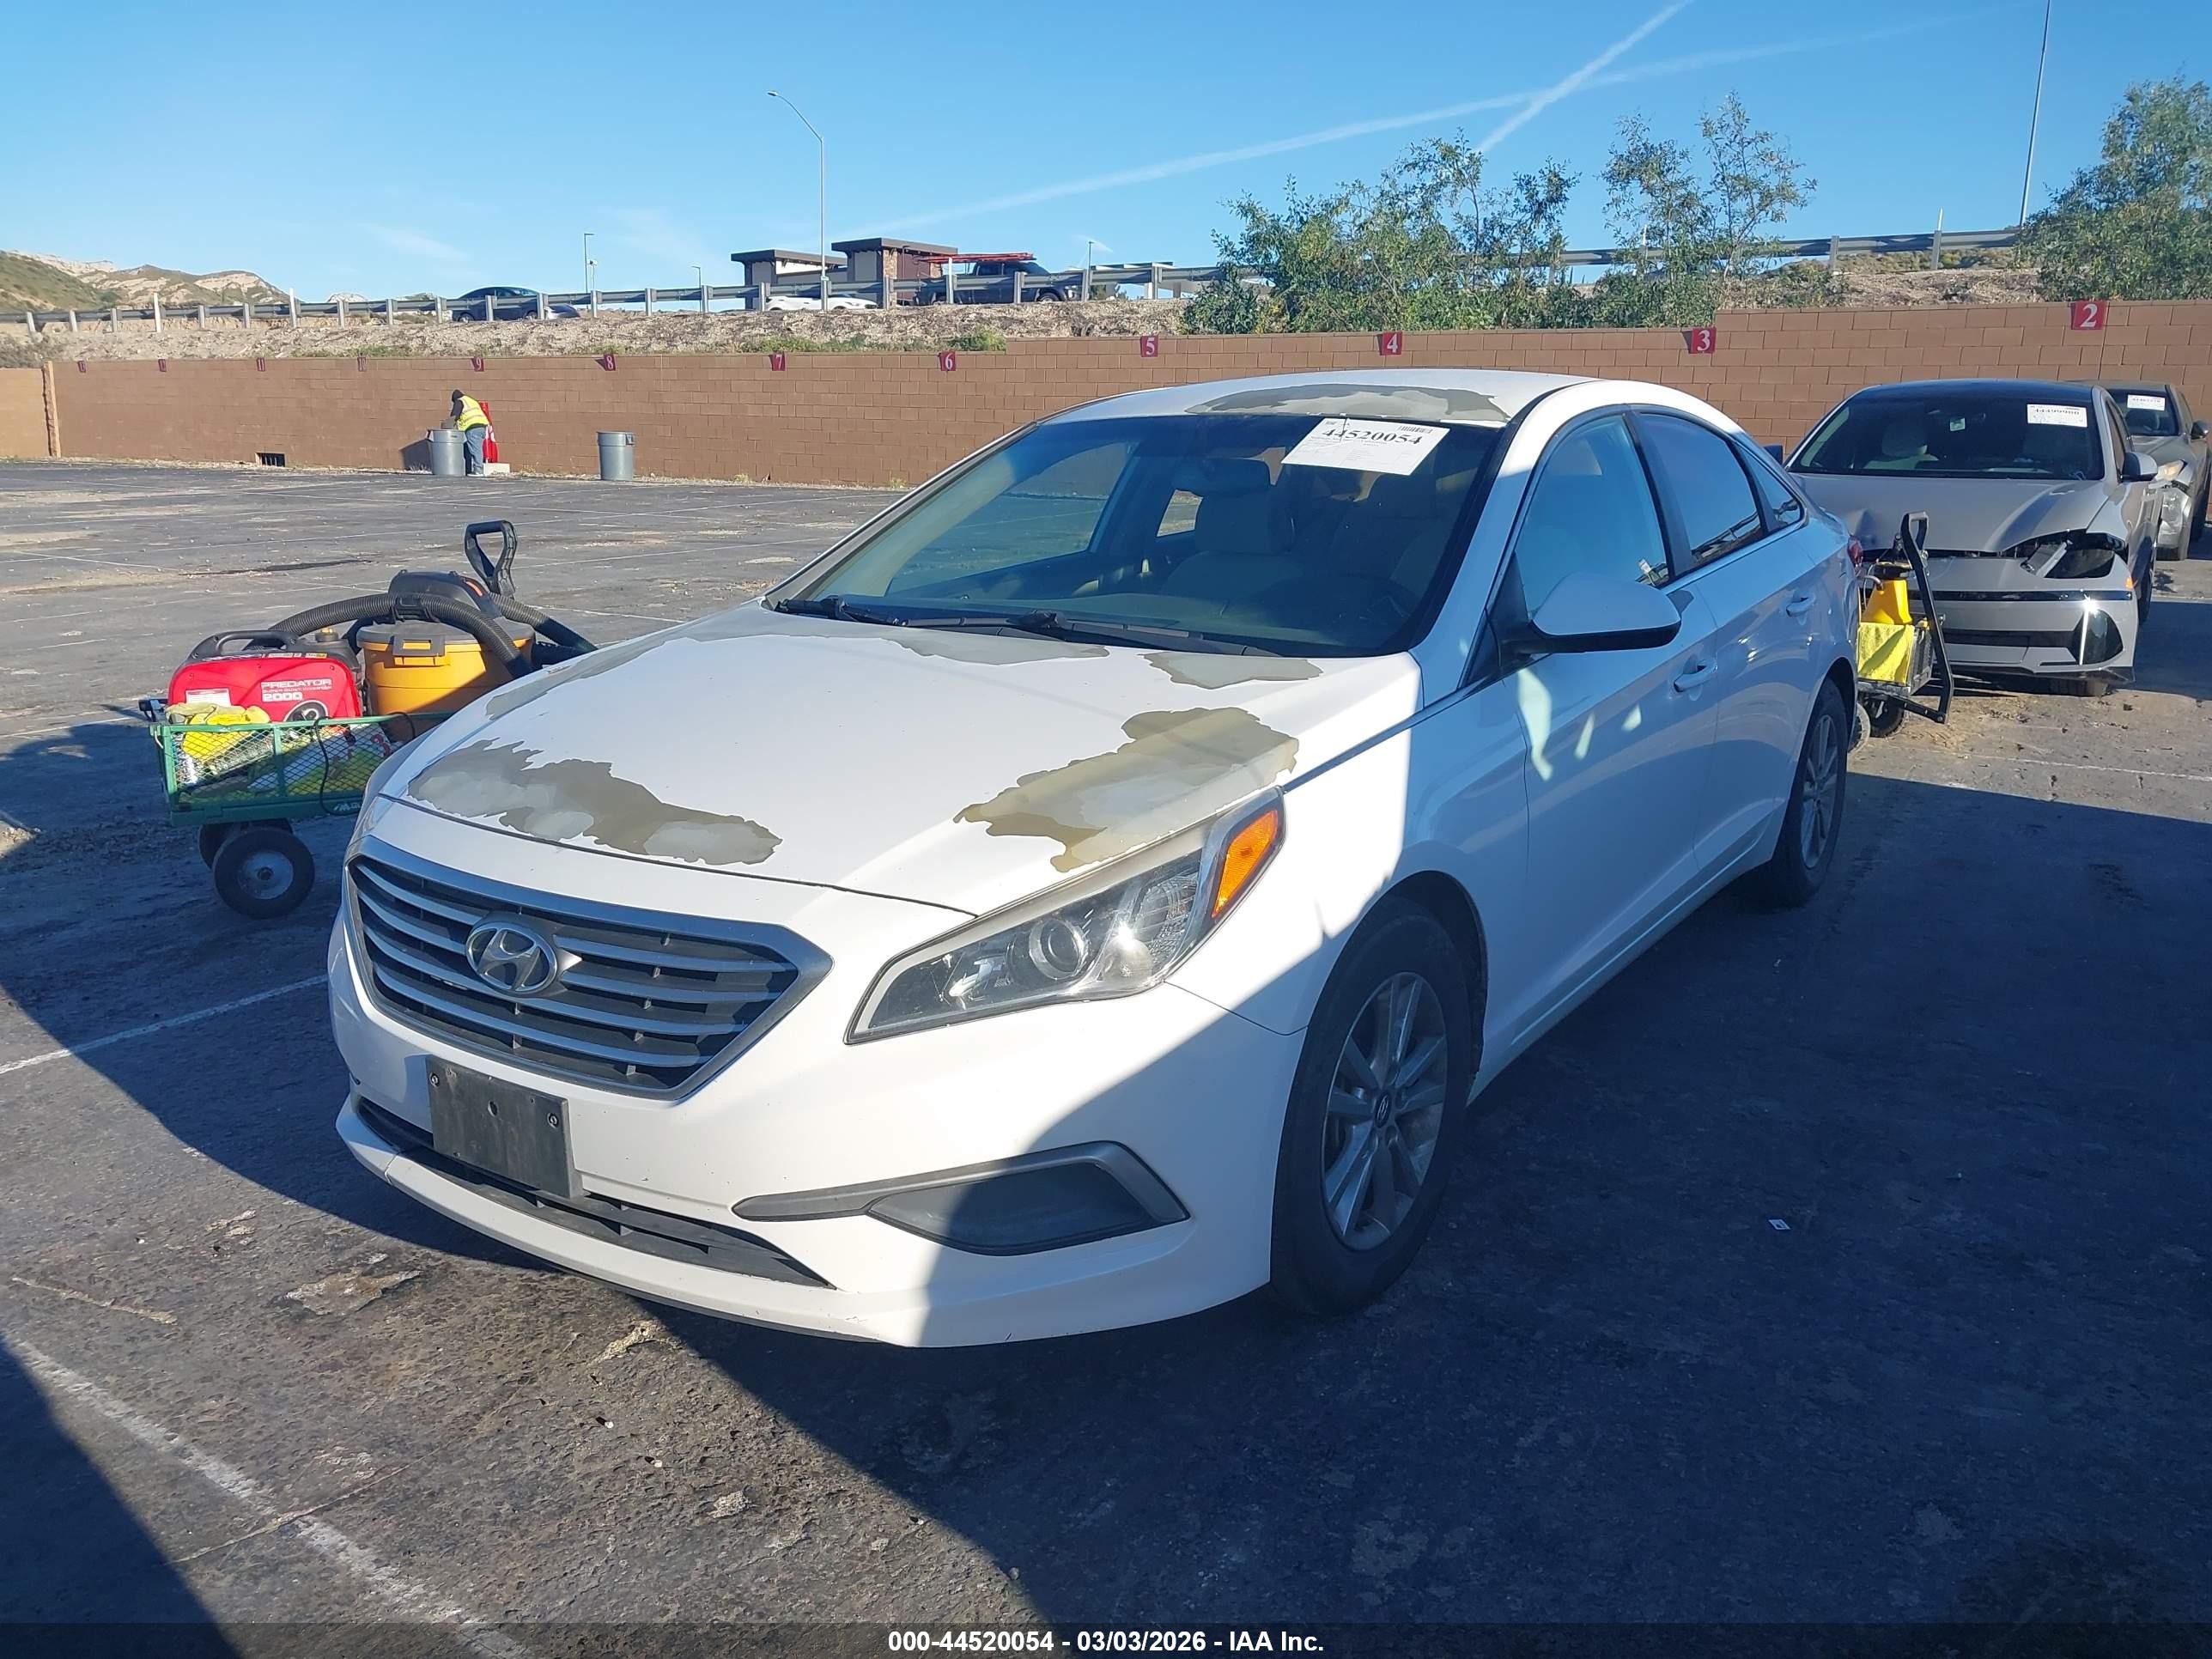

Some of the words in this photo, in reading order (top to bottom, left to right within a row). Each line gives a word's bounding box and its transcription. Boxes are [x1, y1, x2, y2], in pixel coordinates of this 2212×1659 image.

[2080, 304, 2098, 327] 2
[1146, 337, 1155, 356] 5
[1387, 334, 1399, 353] 4
[1697, 330, 1710, 351] 3
[606, 356, 613, 370] 8
[775, 354, 782, 369] 7
[945, 353, 953, 370] 6
[1322, 428, 1423, 445] 44520054
[261, 678, 331, 689] PREDATOR
[263, 692, 302, 702] 2000
